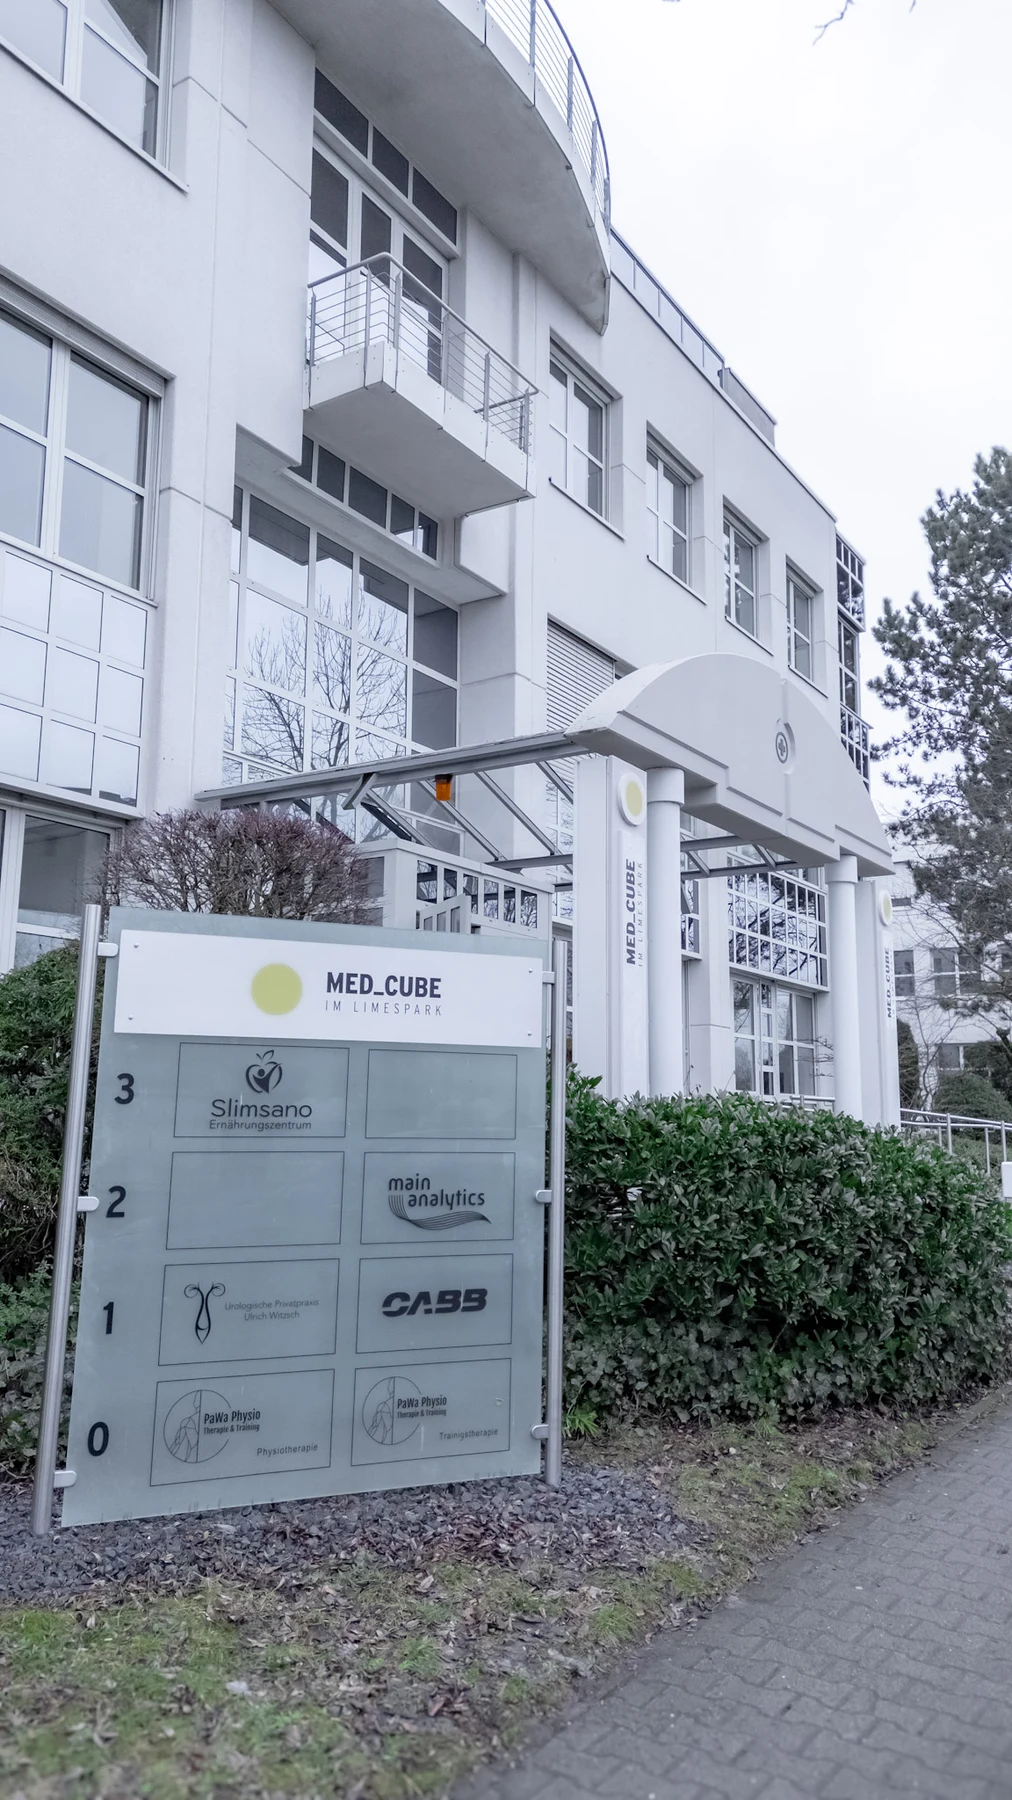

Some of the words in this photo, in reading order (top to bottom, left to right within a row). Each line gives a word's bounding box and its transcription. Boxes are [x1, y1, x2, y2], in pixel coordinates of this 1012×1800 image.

[626, 859, 636, 965] MED_CUBE
[637, 953, 644, 967] IM
[326, 971, 442, 999] MED_CUBE
[325, 1000, 341, 1011] IM
[353, 1001, 442, 1016] LIMESPARK
[115, 1073, 135, 1104] 3
[211, 1098, 312, 1118] Slimsano
[209, 1119, 312, 1132] Ernährungszentrum
[388, 1173, 431, 1191] main
[106, 1185, 127, 1218] 2
[408, 1188, 485, 1211] analytics
[225, 1301, 272, 1311] Urologische
[274, 1299, 320, 1309] Privatpraxis
[382, 1288, 488, 1317] CABB
[102, 1302, 115, 1335] 1
[244, 1312, 267, 1321] Ulrich
[269, 1310, 300, 1320] Witzsch
[397, 1398, 419, 1409] PaWa
[421, 1395, 447, 1408] Physio
[203, 1412, 229, 1424] PaWa
[231, 1408, 261, 1424] Physio
[397, 1410, 420, 1419] Therapie
[420, 1409, 425, 1417] &
[425, 1408, 447, 1417] Training
[203, 1425, 229, 1435] Therapie
[229, 1424, 235, 1433] &
[236, 1423, 260, 1432] Training
[439, 1427, 498, 1441] Trainigstherapie
[87, 1421, 110, 1457] 0
[256, 1442, 319, 1457] Physiotherapie
